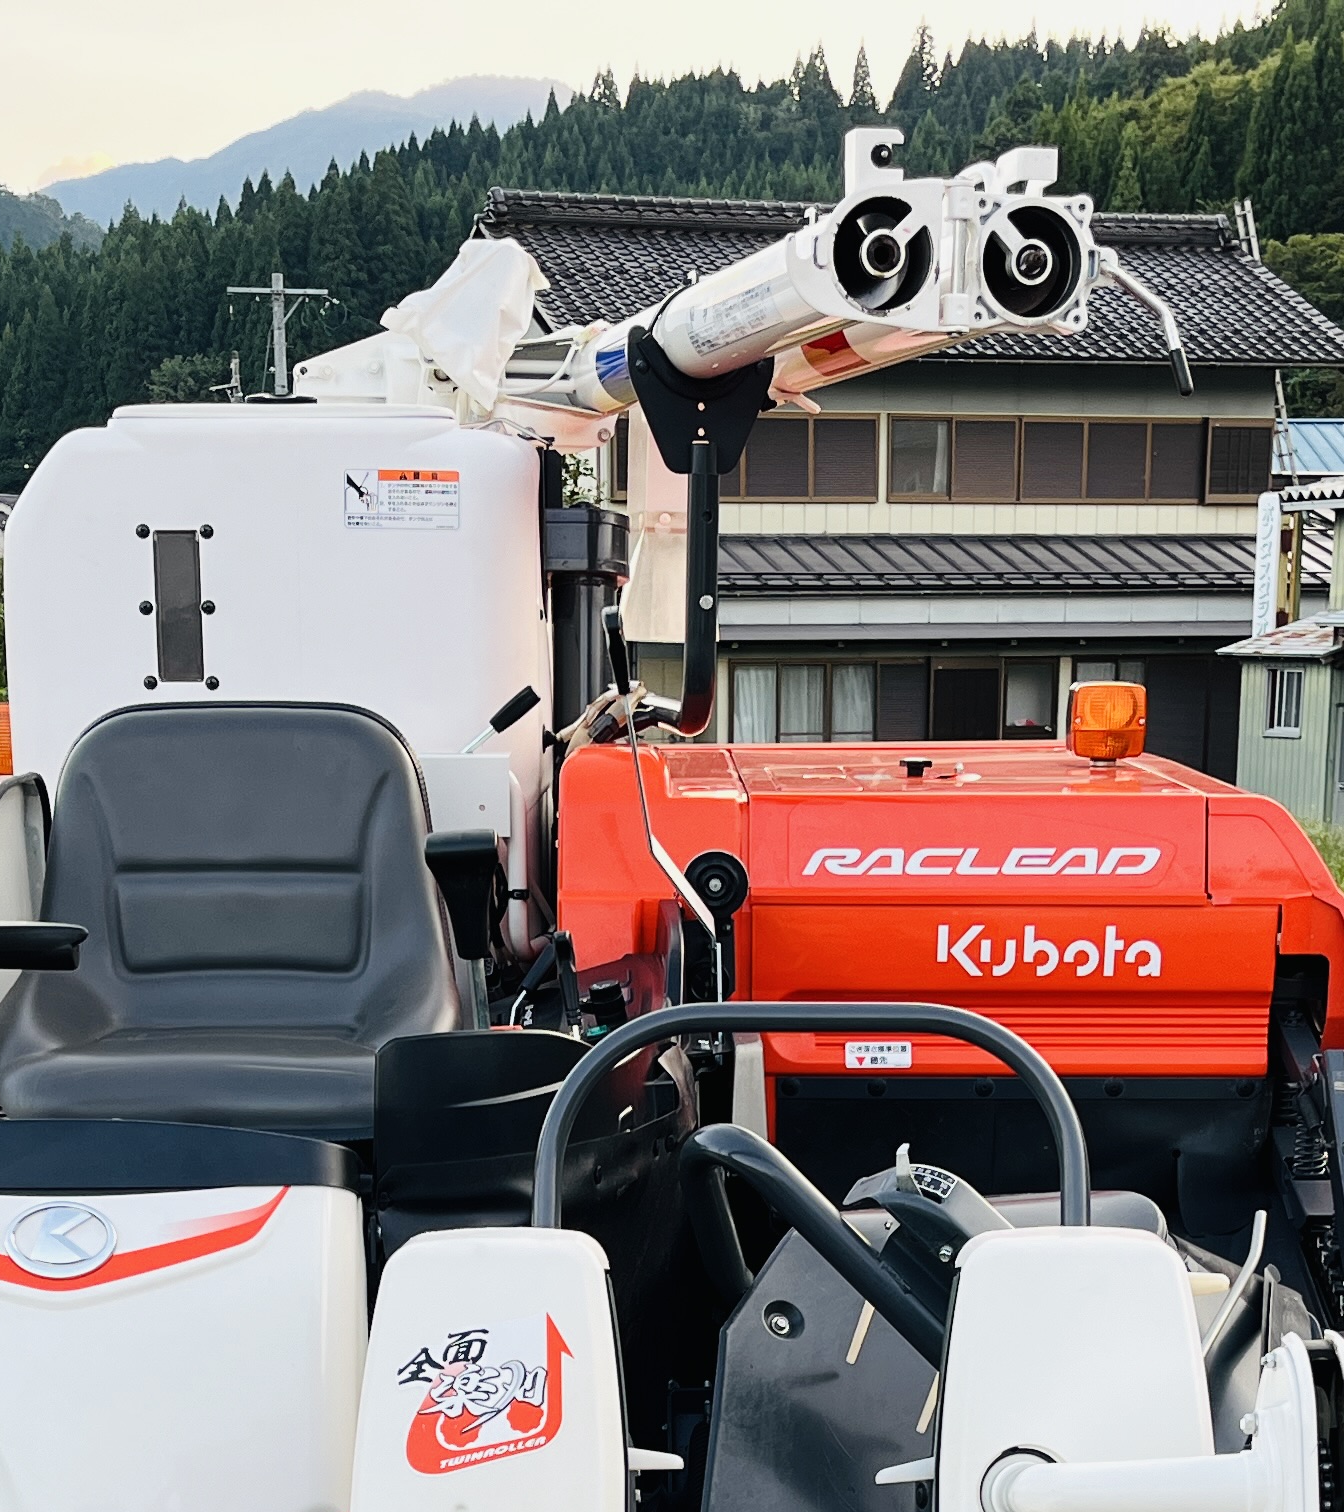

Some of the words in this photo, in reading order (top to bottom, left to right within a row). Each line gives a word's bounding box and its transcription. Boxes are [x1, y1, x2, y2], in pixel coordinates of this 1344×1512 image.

[801, 847, 1161, 876] RACLEAD
[936, 924, 1162, 977] Kubota
[439, 1435, 547, 1469] TWINROLLER
